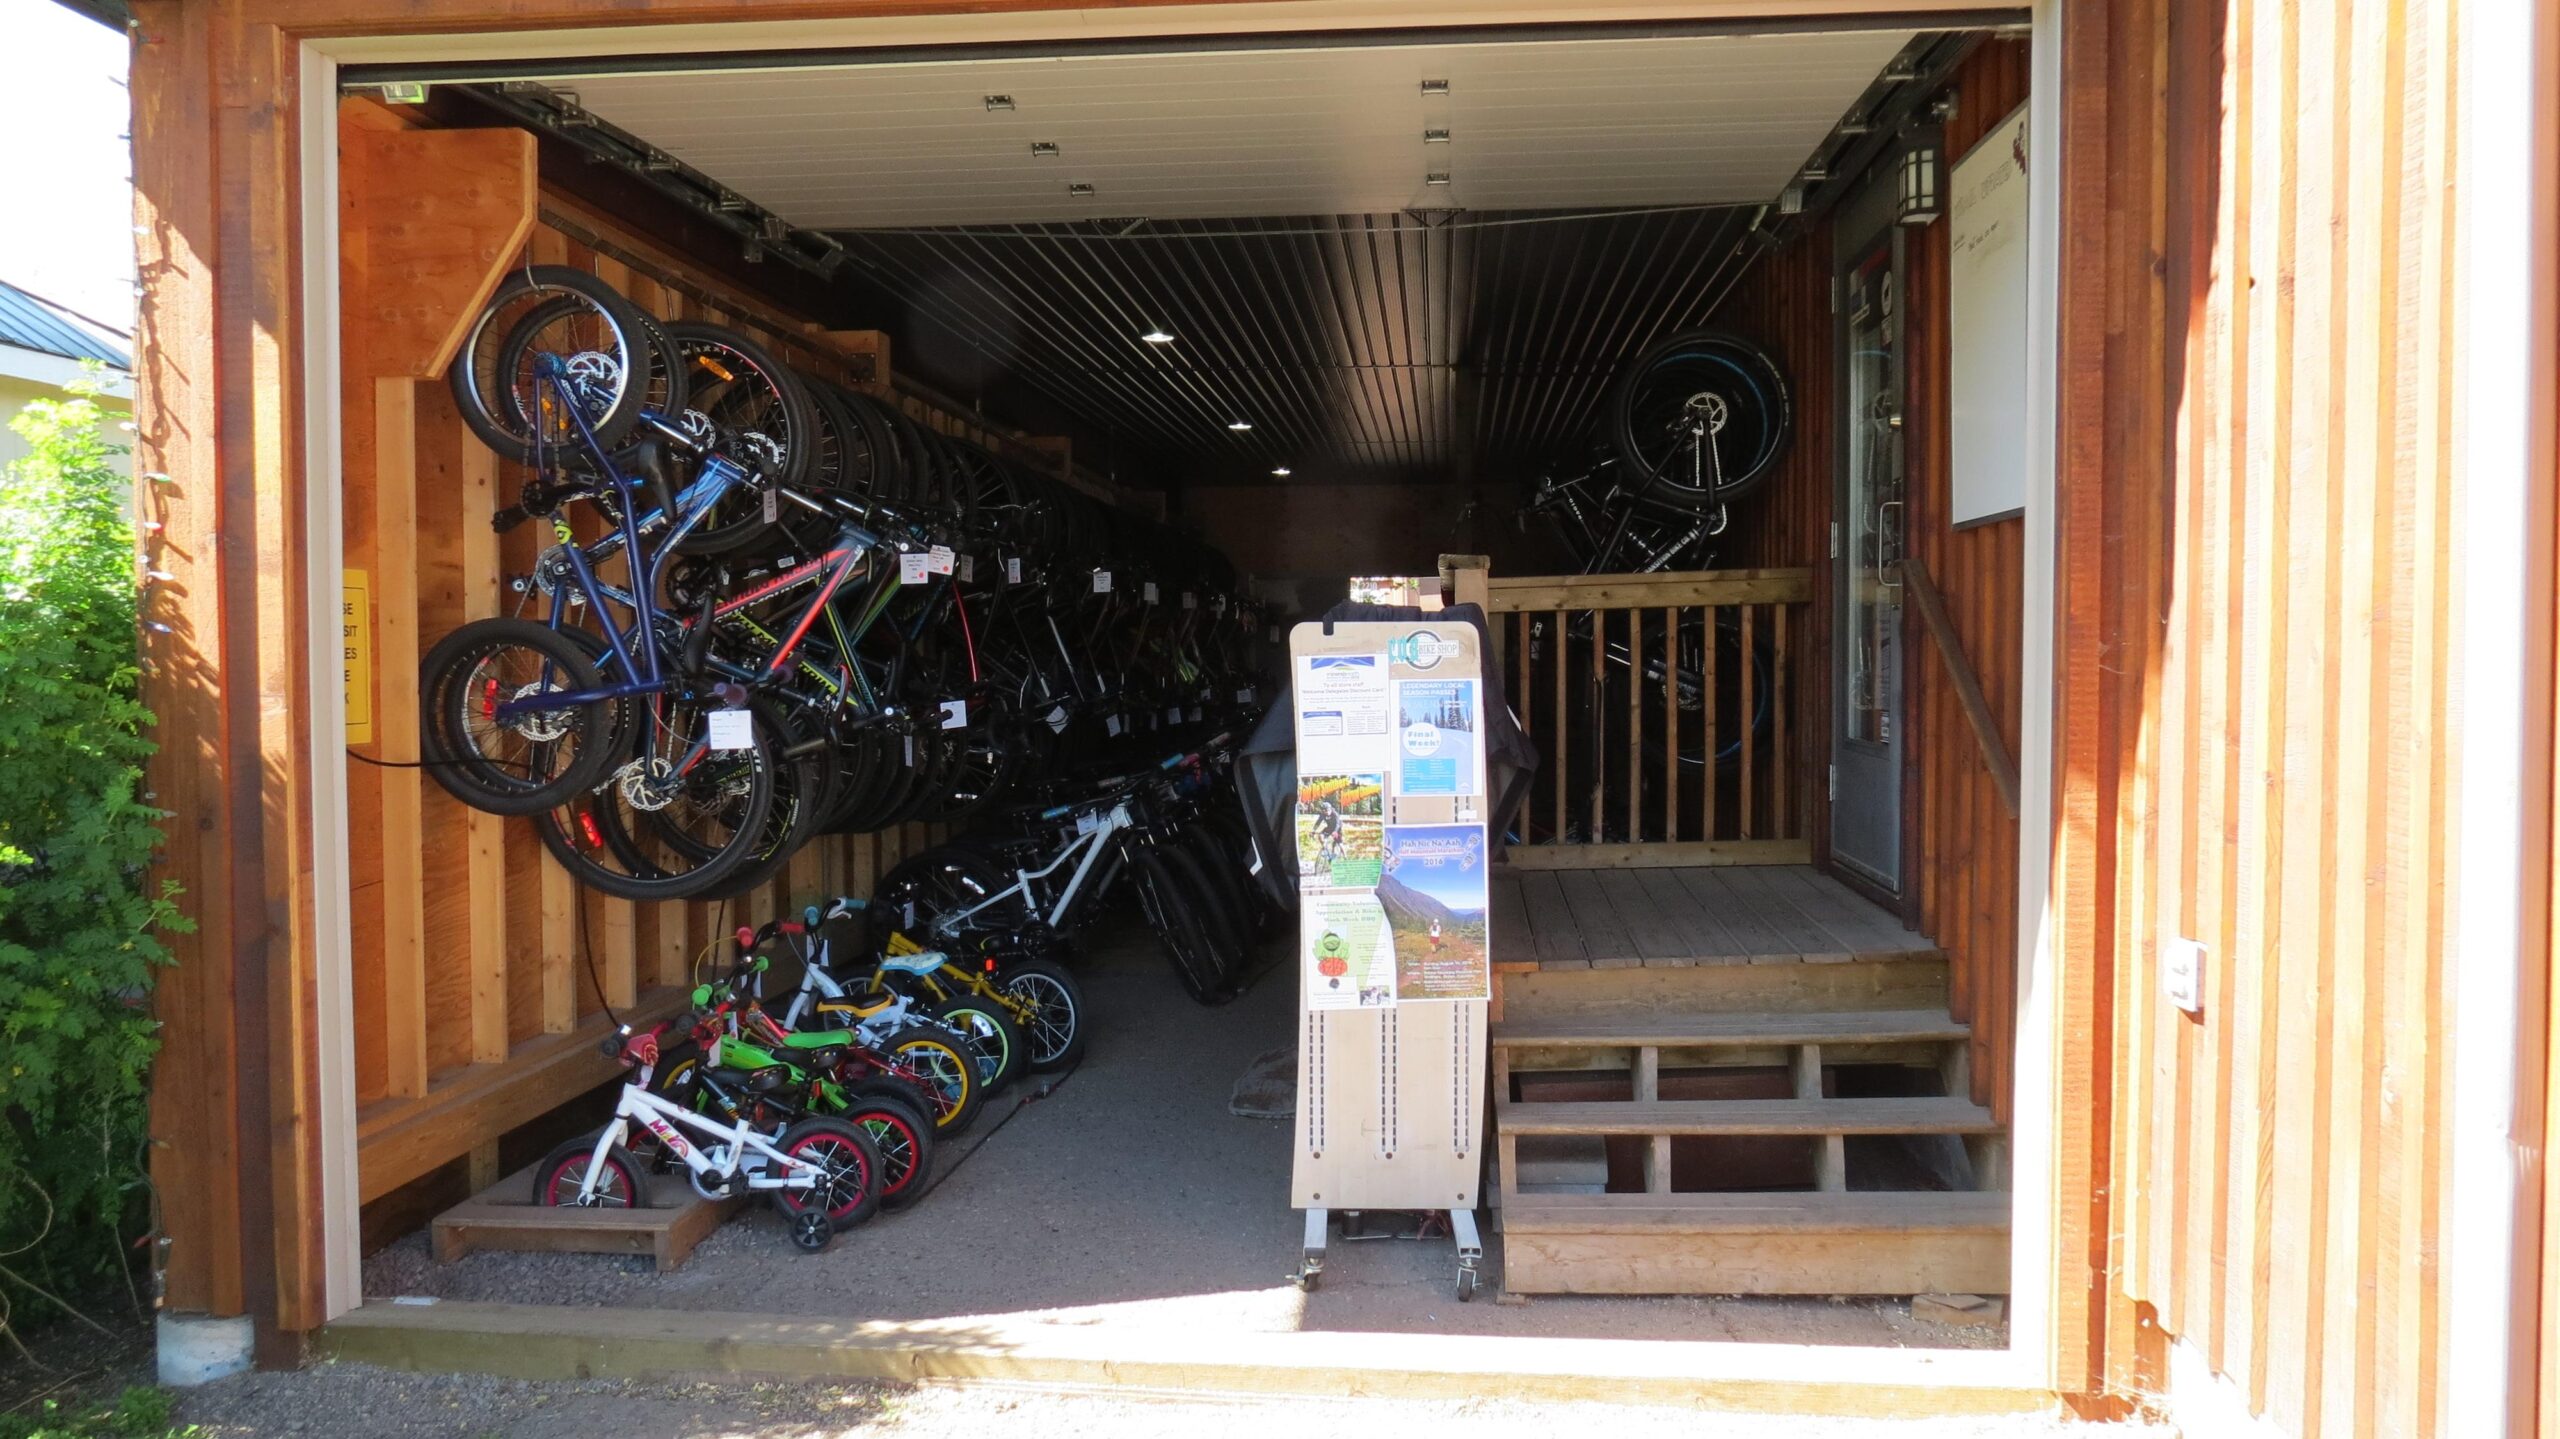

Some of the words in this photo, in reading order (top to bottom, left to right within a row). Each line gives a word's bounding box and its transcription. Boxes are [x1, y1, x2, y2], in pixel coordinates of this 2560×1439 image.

[1418, 644, 1436, 655] BIKE
[1437, 644, 1457, 655] SHOP
[1408, 730, 1434, 738] Final
[1425, 858, 1443, 866] 2016
